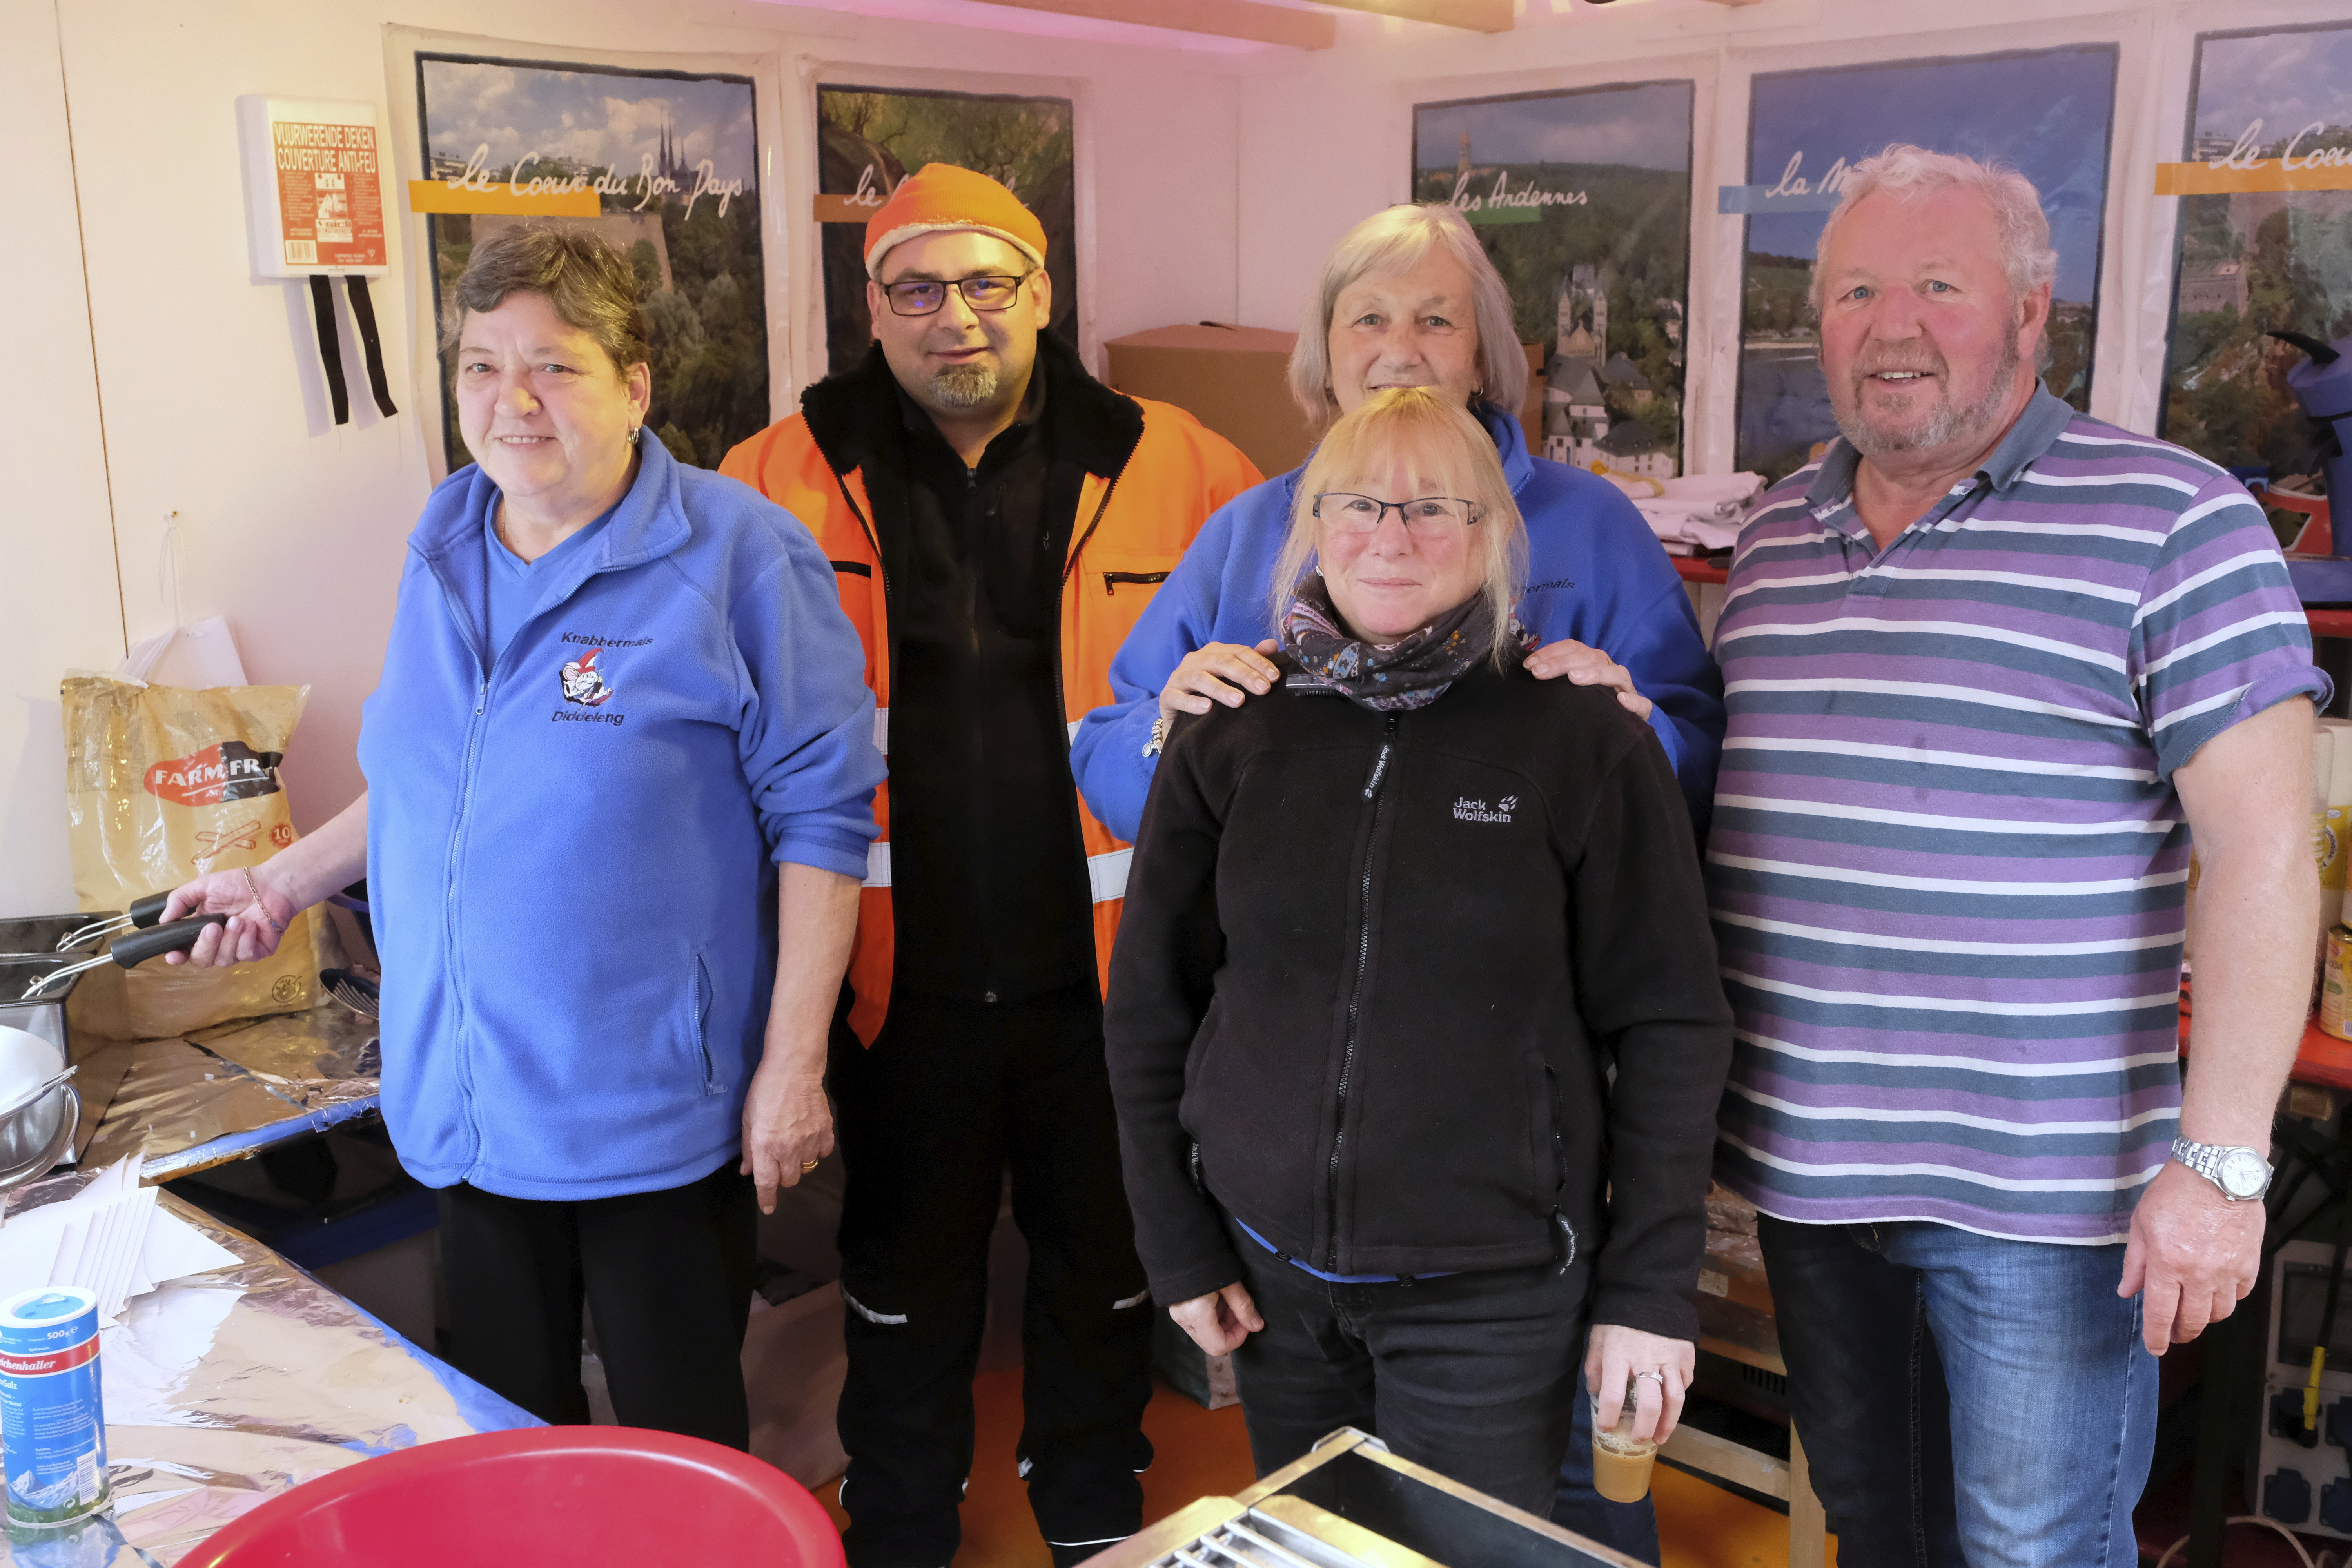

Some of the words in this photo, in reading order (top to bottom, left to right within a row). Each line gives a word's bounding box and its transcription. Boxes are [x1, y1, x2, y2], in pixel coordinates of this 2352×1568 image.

[276, 124, 343, 147] VUURWERENDE
[345, 127, 374, 149] DEKEN
[278, 148, 336, 171] COUVERTURE
[339, 151, 375, 173] ANTI-FEU
[593, 163, 628, 195] du
[634, 152, 681, 211] Bon
[684, 159, 742, 220] Pays
[1488, 170, 1588, 209] Ardennes
[561, 632, 653, 648] Knabbermais
[552, 711, 624, 726] Diddeleng
[155, 764, 225, 786] FARM
[1368, 760, 1386, 788] Wolfskin
[1454, 797, 1486, 810] Jack
[1453, 808, 1512, 822] Wolfskin
[274, 826, 290, 840] 10
[47, 1330, 69, 1340] 500g
